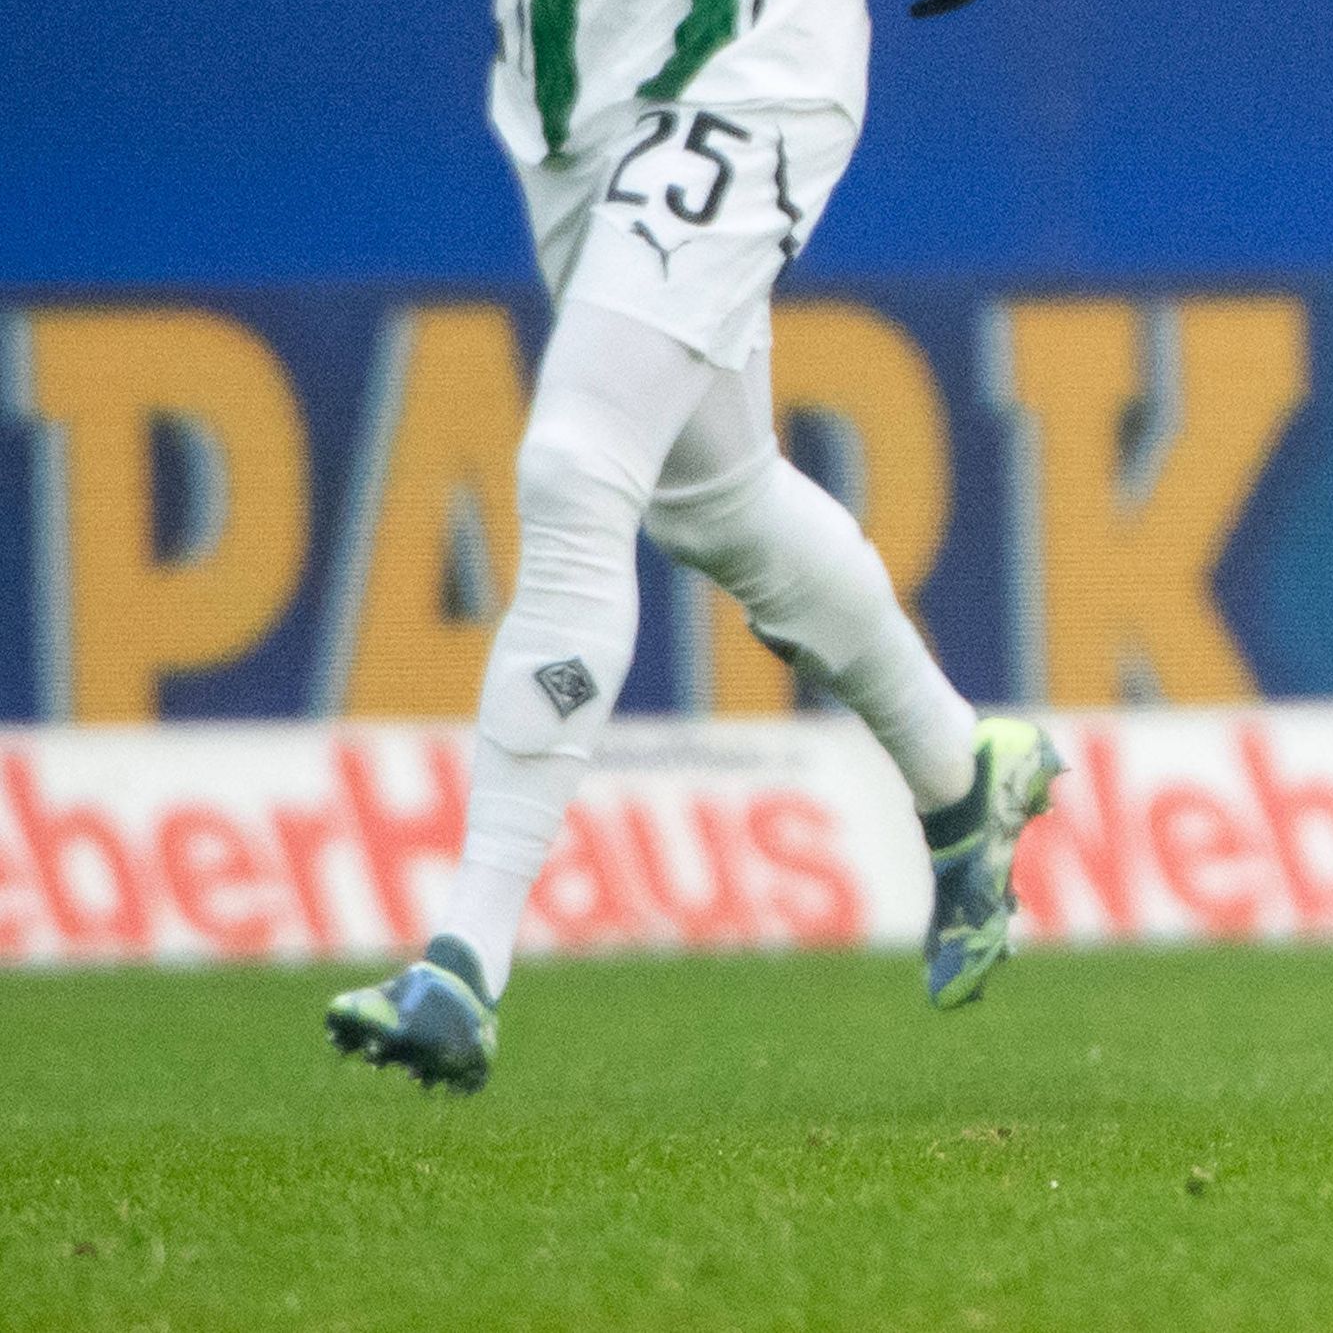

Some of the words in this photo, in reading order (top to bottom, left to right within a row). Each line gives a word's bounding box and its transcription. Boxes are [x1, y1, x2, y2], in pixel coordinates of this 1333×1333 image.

[604, 109, 752, 227] 25
[12, 298, 1312, 726] PARK
[0, 724, 870, 954] berHaus
